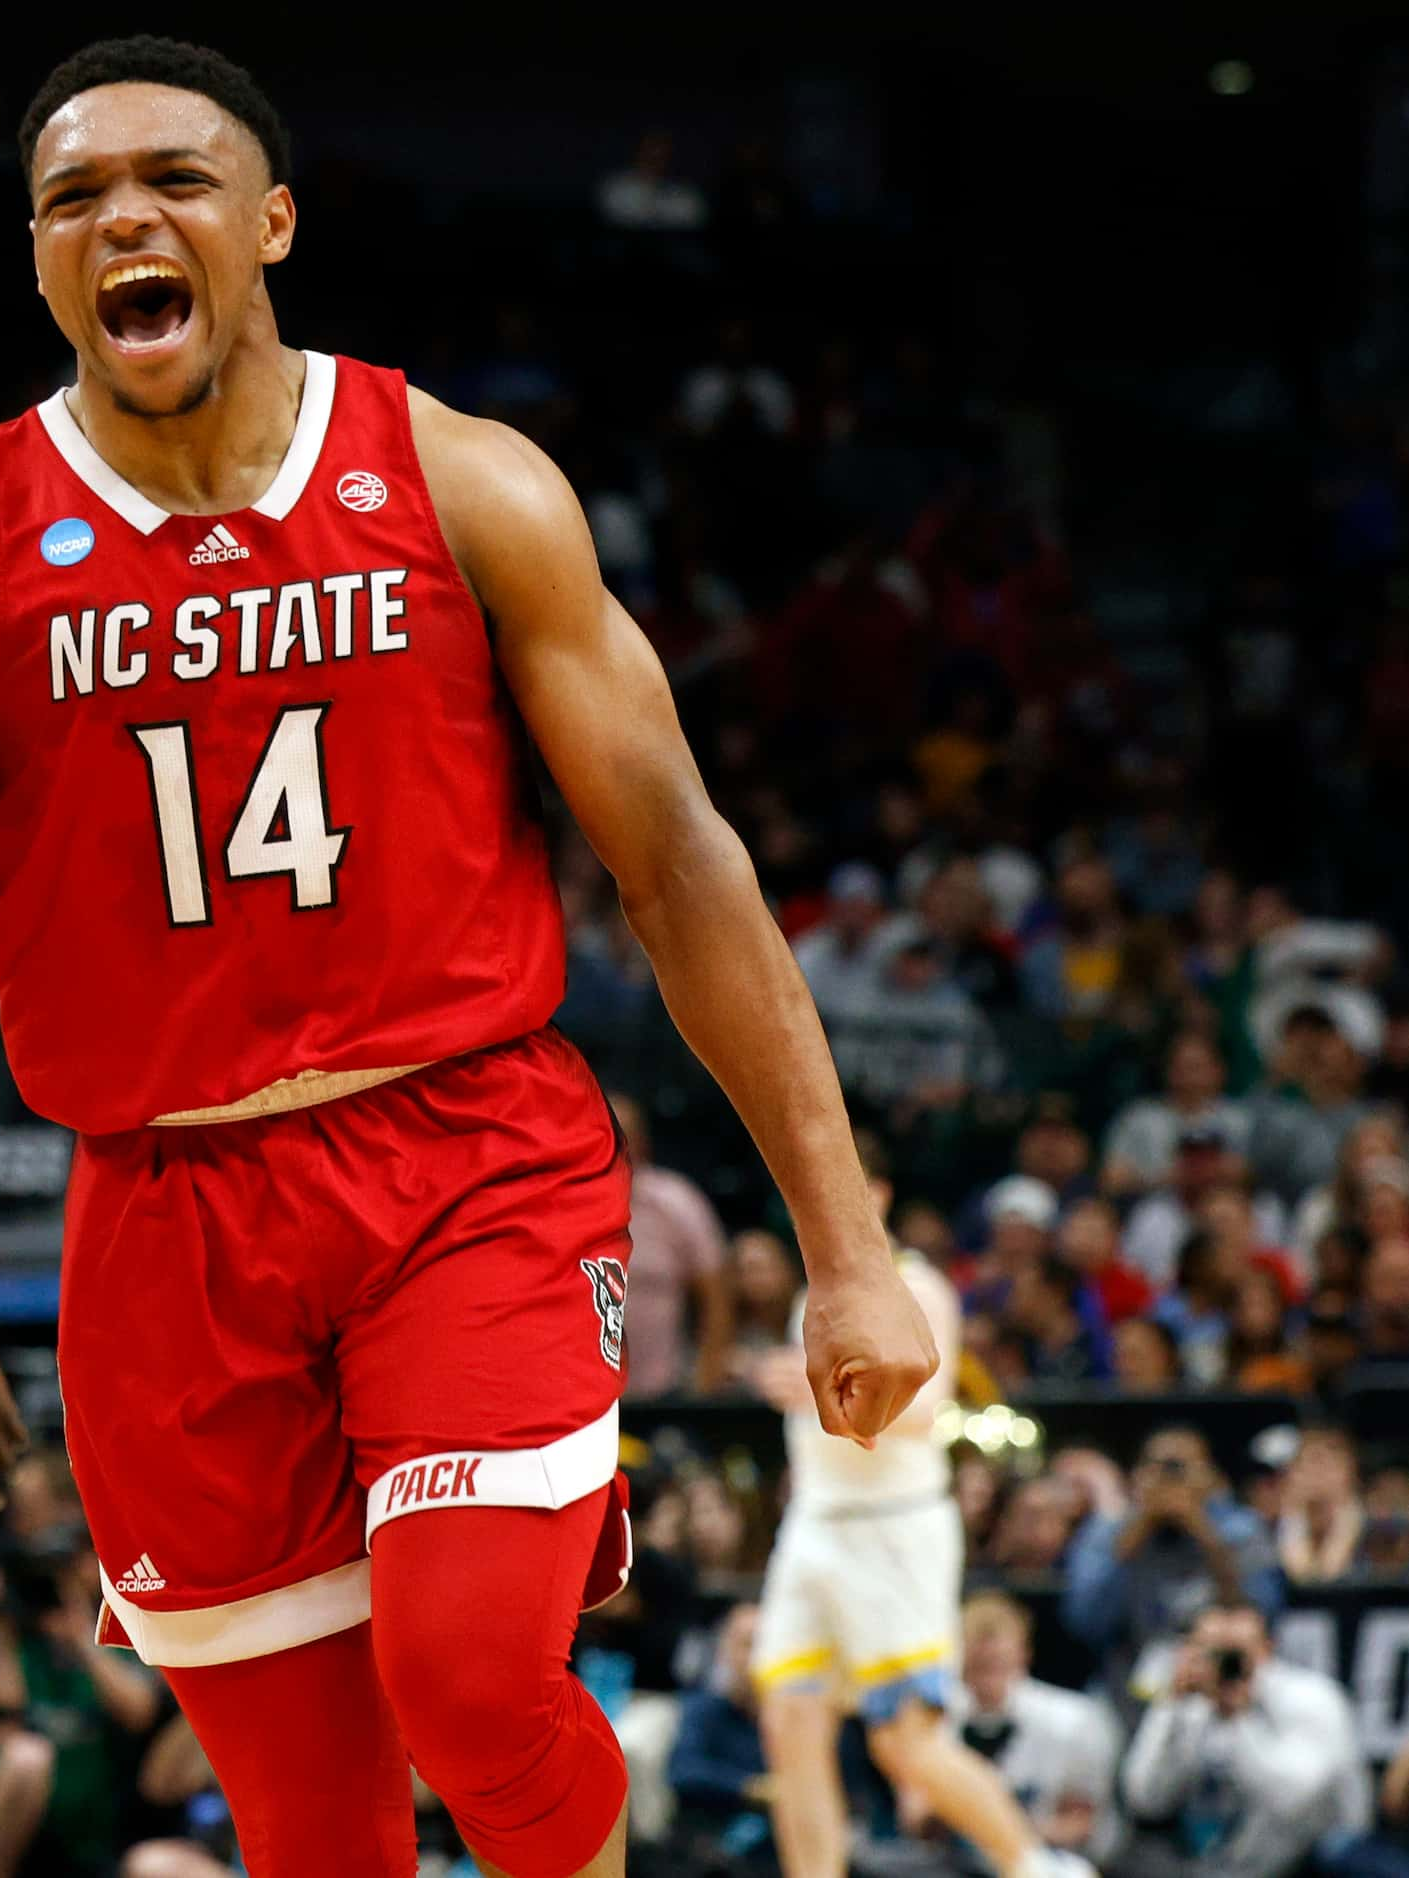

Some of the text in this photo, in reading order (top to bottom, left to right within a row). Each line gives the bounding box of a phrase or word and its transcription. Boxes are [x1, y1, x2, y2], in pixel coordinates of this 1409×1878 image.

[48, 536, 90, 557] NCAA
[188, 546, 251, 566] adidas
[49, 568, 408, 701] NC STATE
[124, 699, 354, 929] 14
[386, 1456, 482, 1513] PACK
[115, 1577, 167, 1592] adidas
